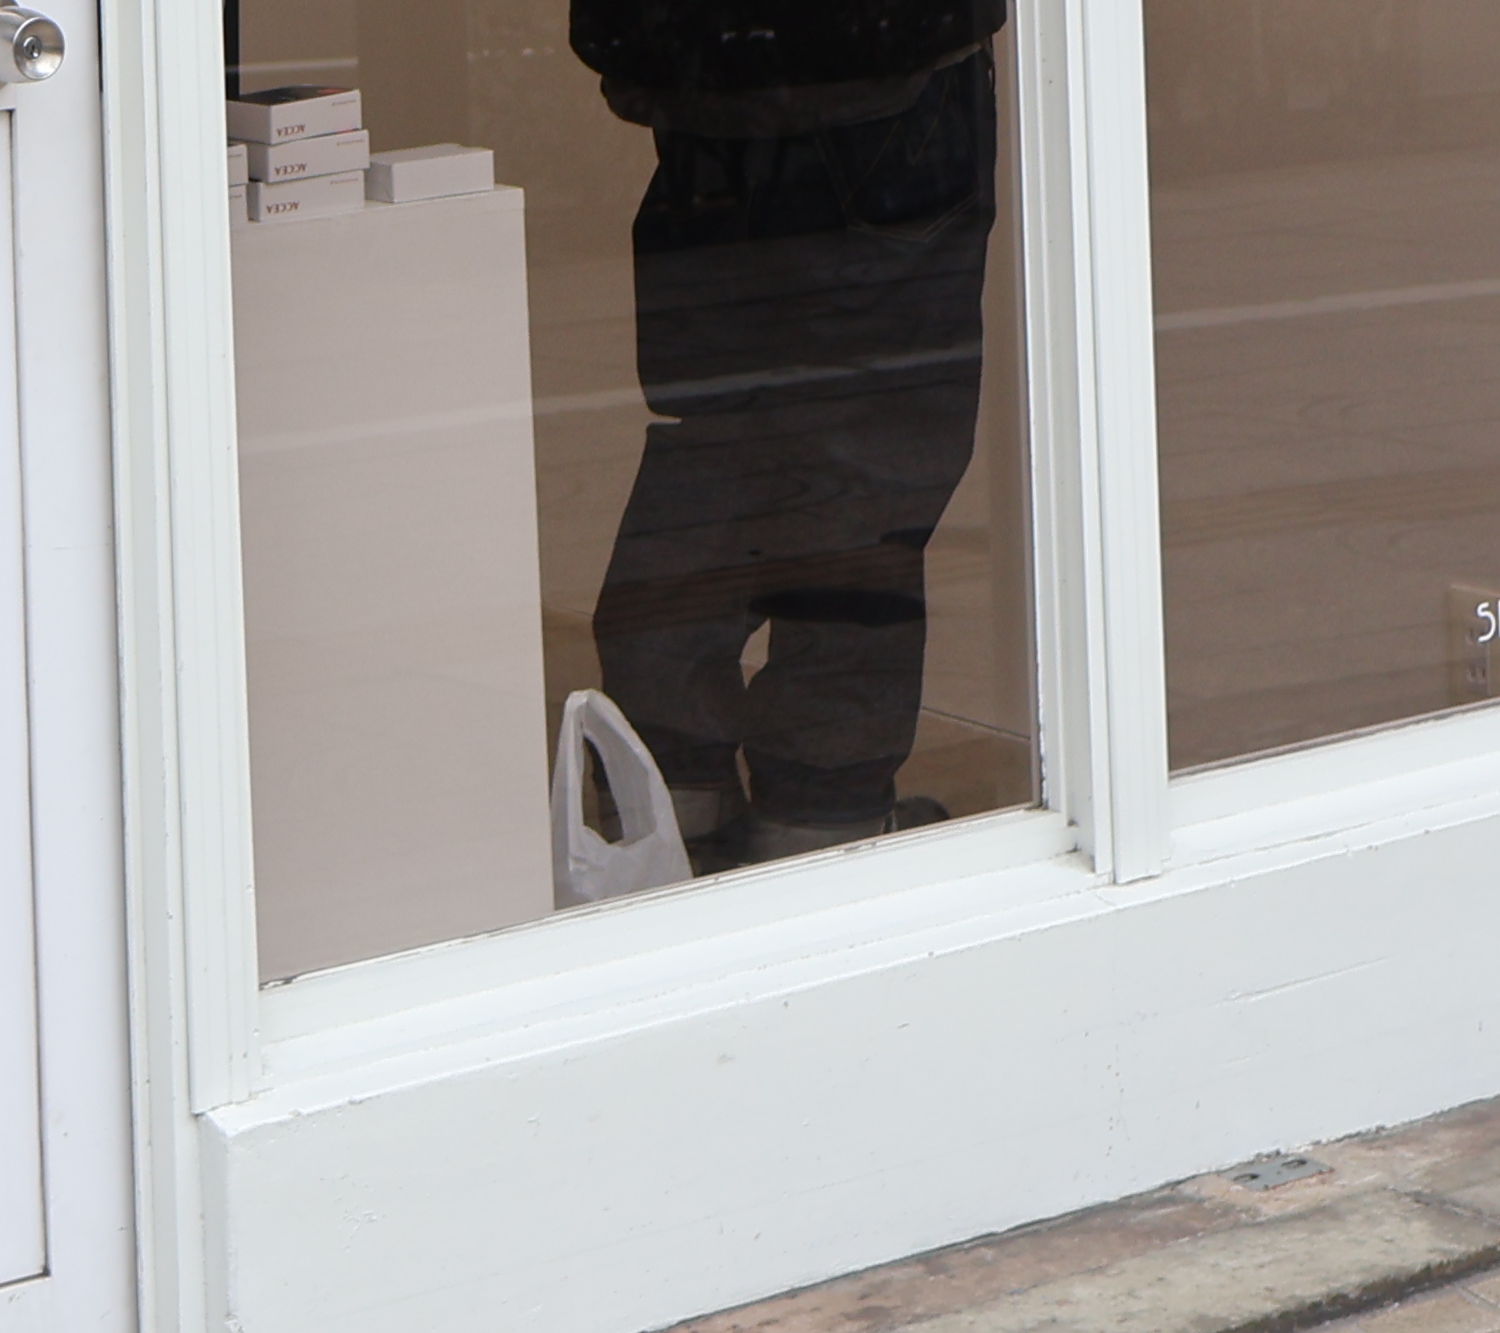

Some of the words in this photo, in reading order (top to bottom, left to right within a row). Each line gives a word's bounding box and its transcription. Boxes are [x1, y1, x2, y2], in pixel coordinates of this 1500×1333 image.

[276, 124, 306, 137] ACCEA
[274, 163, 307, 175] ACCEA
[266, 201, 299, 214] ACCEA
